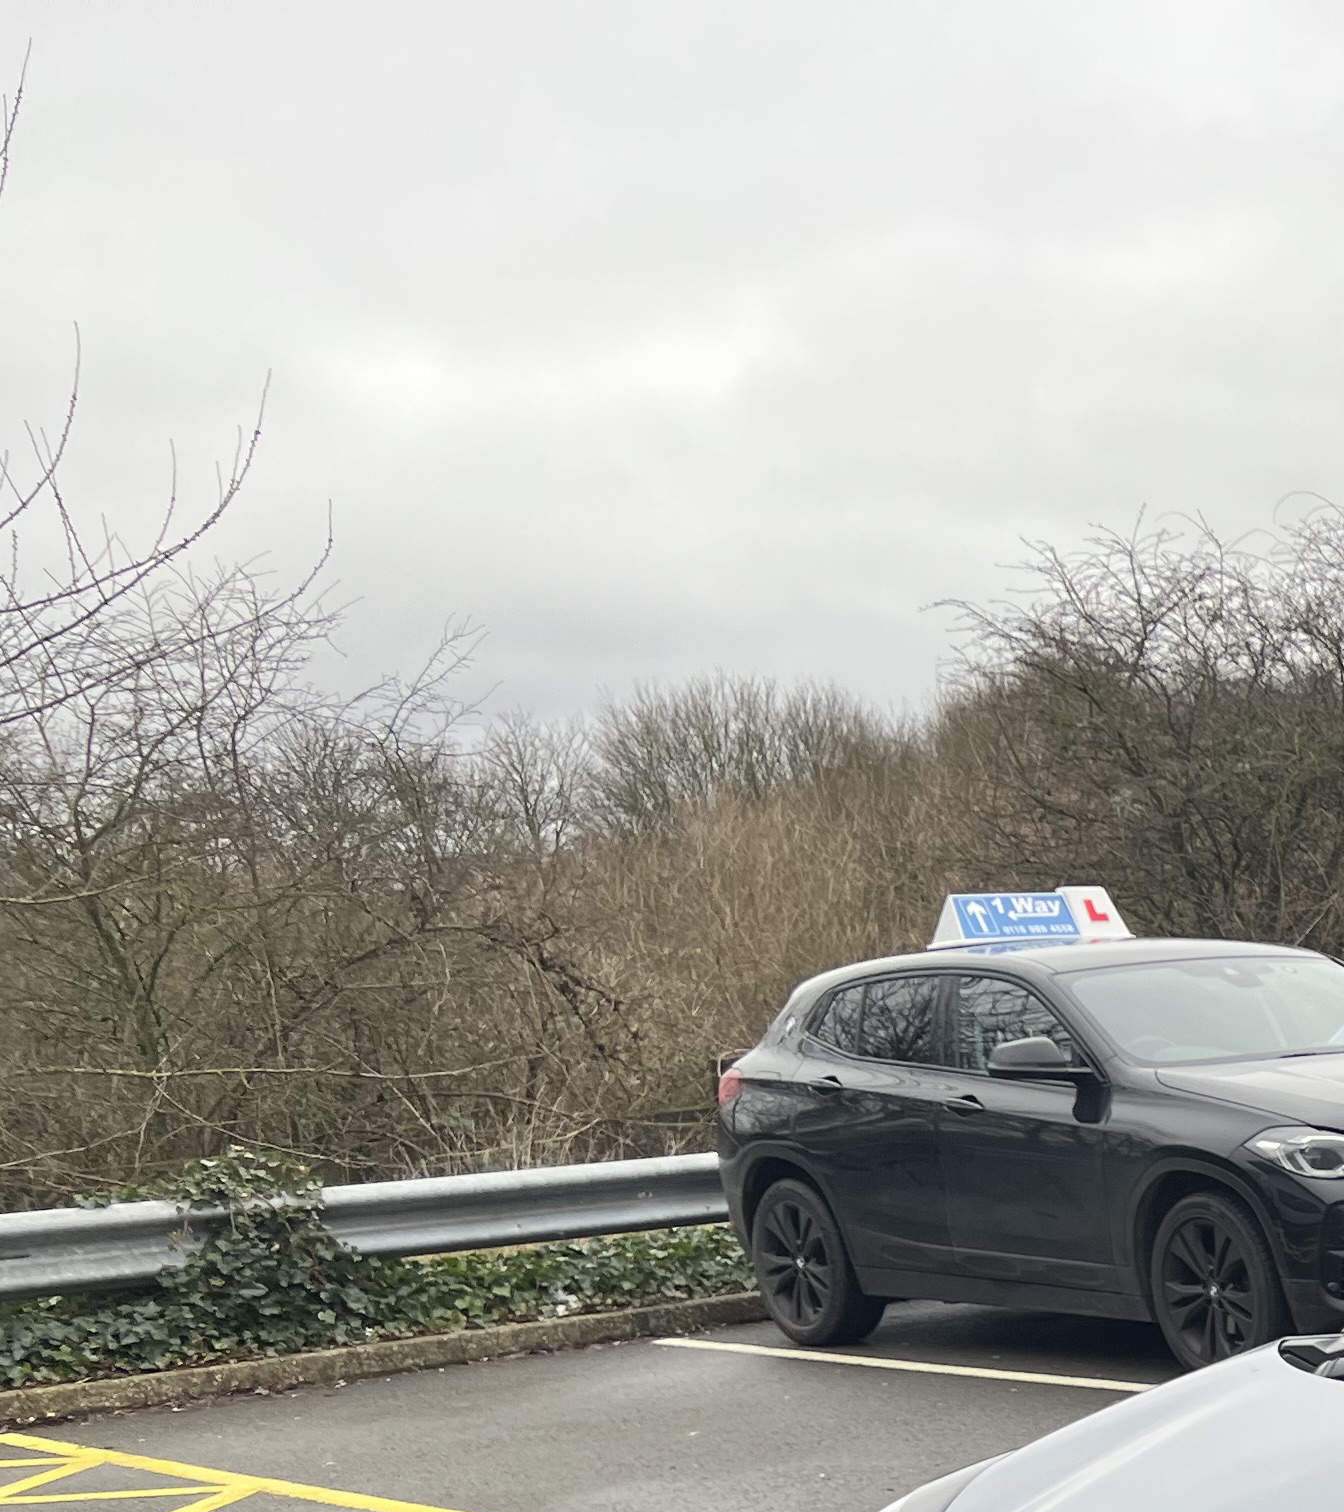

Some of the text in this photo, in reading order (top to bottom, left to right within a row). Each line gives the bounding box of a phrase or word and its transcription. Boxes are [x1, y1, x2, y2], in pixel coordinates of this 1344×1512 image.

[991, 896, 1061, 916] 1 Way
[1084, 899, 1109, 922] L
